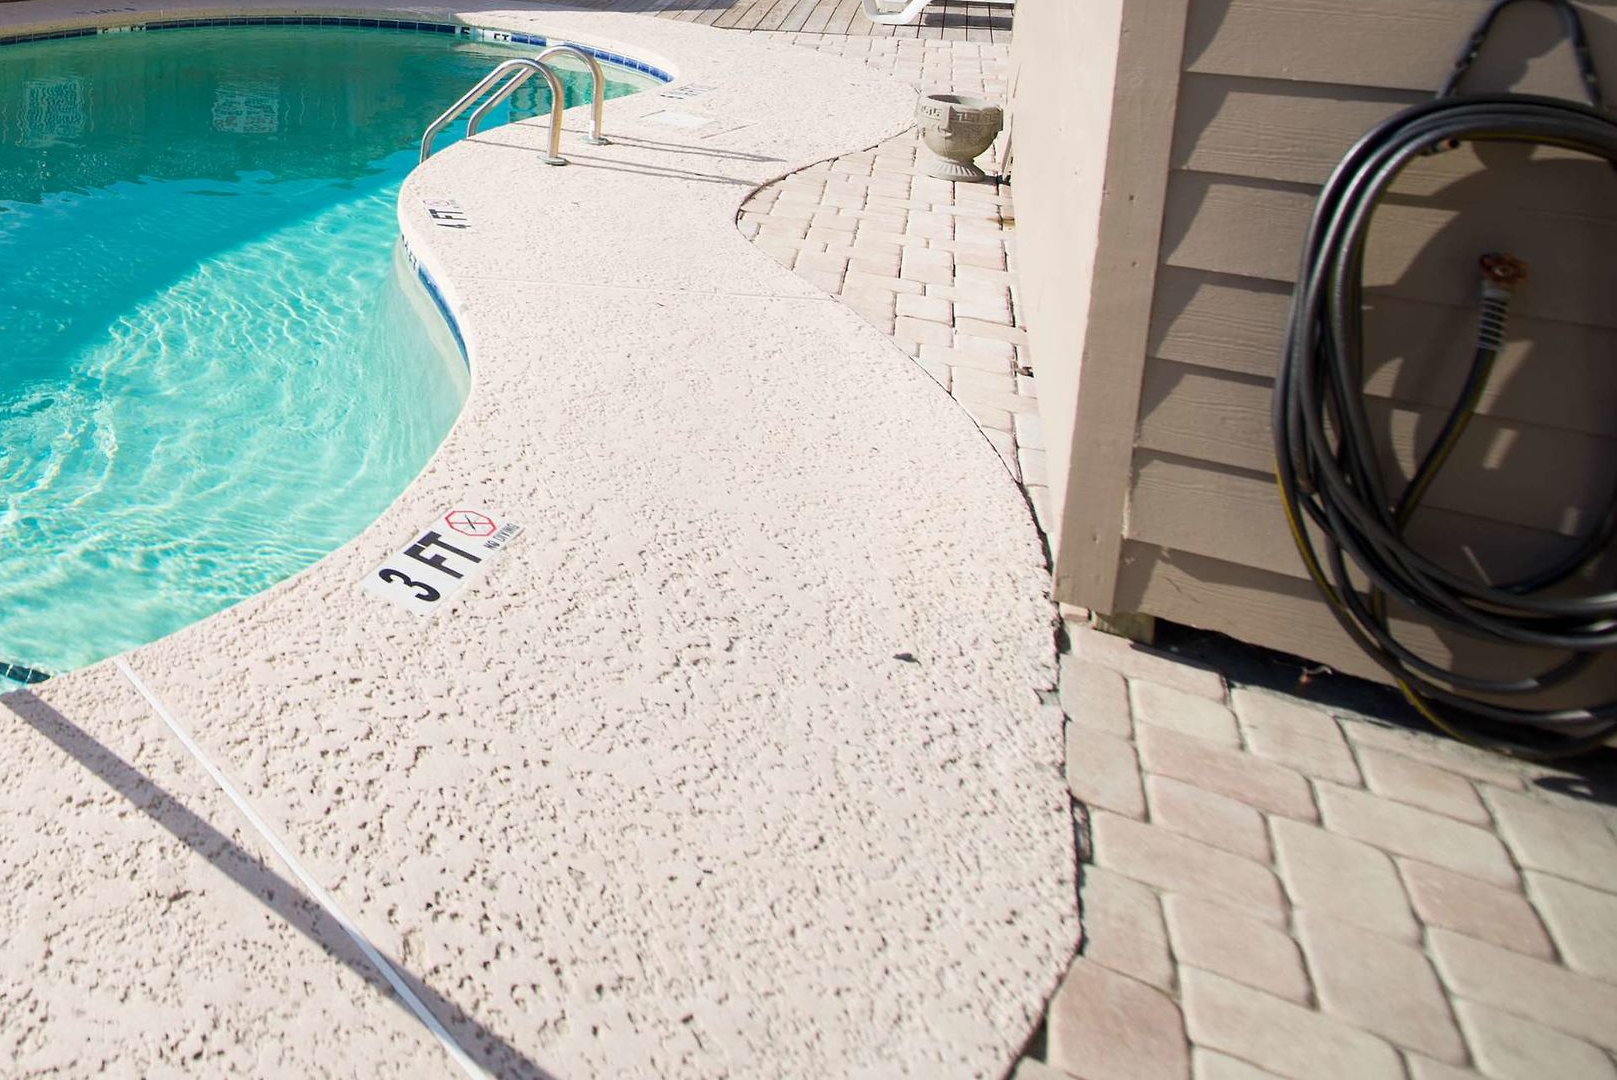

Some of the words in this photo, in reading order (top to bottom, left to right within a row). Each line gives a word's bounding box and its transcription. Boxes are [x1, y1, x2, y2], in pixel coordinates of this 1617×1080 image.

[428, 209, 467, 221] FT
[403, 530, 482, 579] FT
[378, 568, 441, 602] 3
